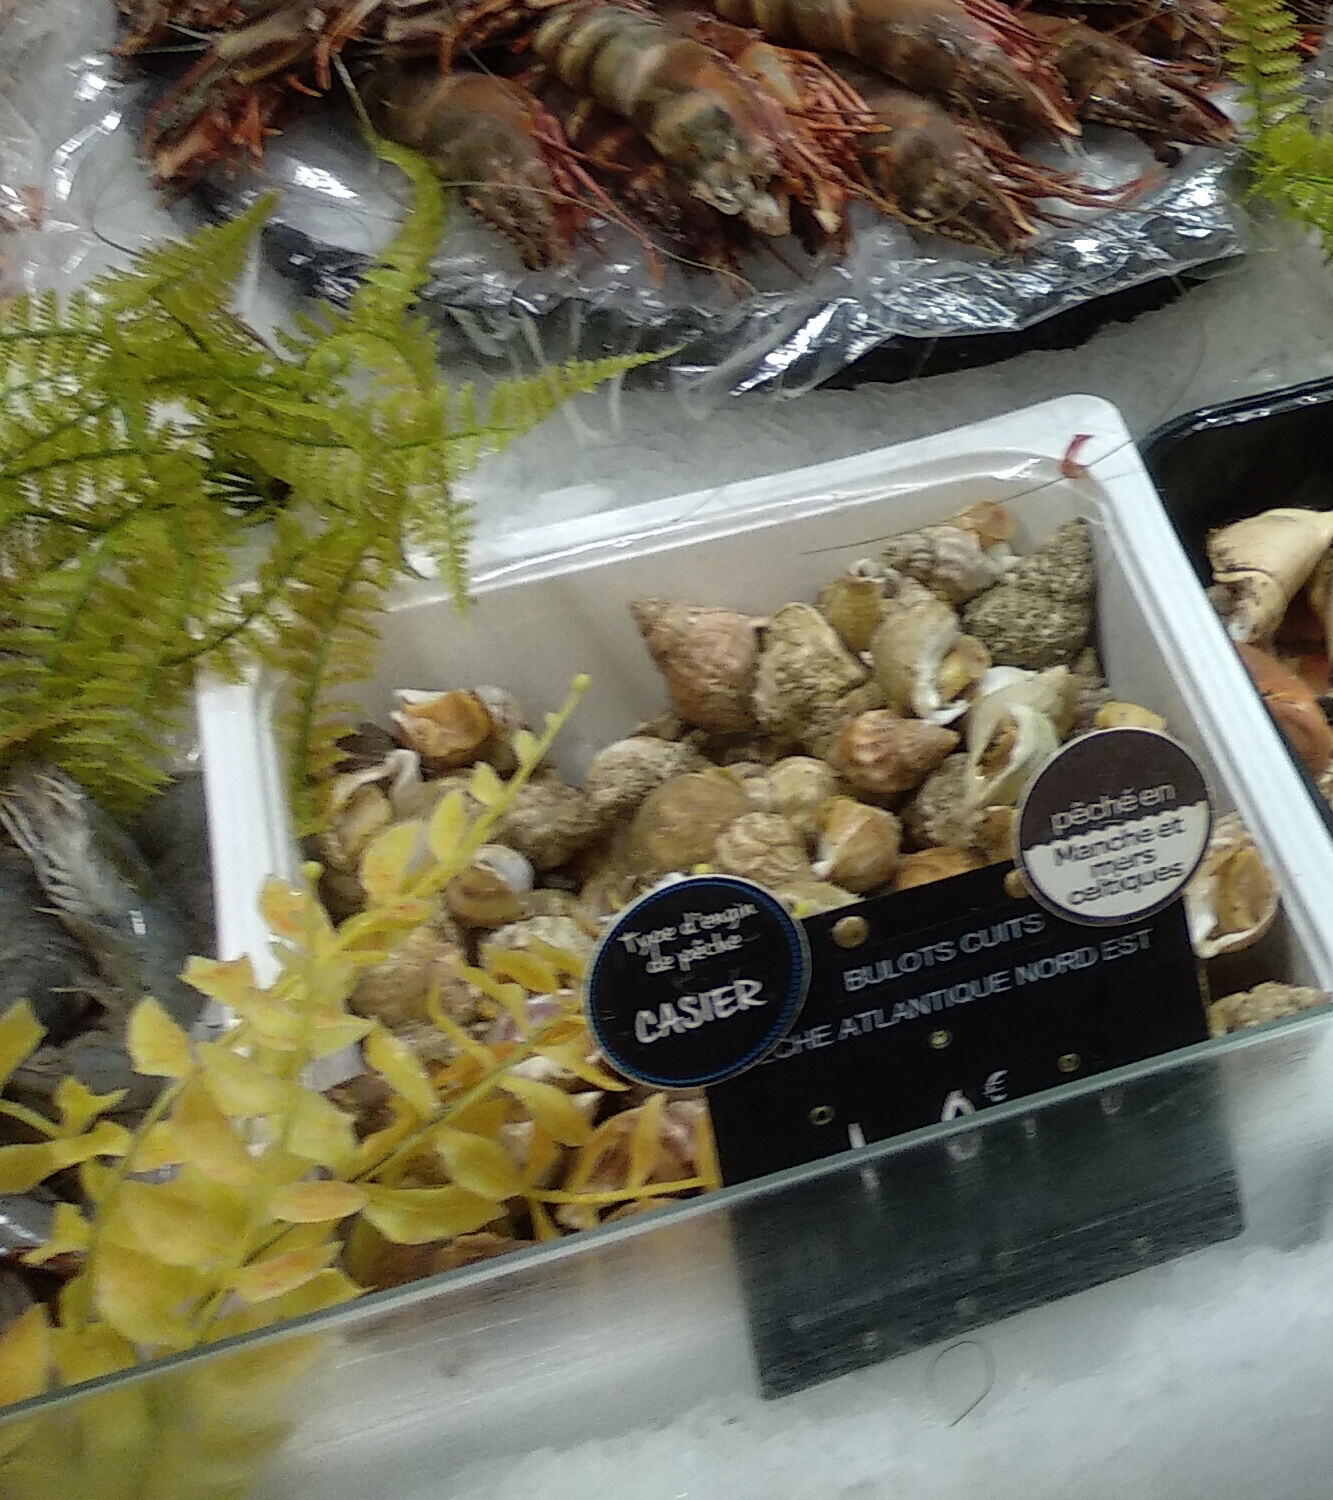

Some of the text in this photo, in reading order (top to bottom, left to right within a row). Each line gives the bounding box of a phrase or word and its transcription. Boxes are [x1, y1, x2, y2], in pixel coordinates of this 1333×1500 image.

[1138, 783, 1178, 808] en
[1053, 818, 1187, 868] Manche et
[1090, 848, 1157, 880] mers
[1067, 860, 1186, 906] celtiques
[841, 912, 1048, 993] BULOTS CUITS
[836, 971, 1013, 1041] ATLANTIQUE
[1013, 945, 1100, 987] NORD
[1101, 927, 1155, 962] EST
[634, 979, 770, 1045] CASIER
